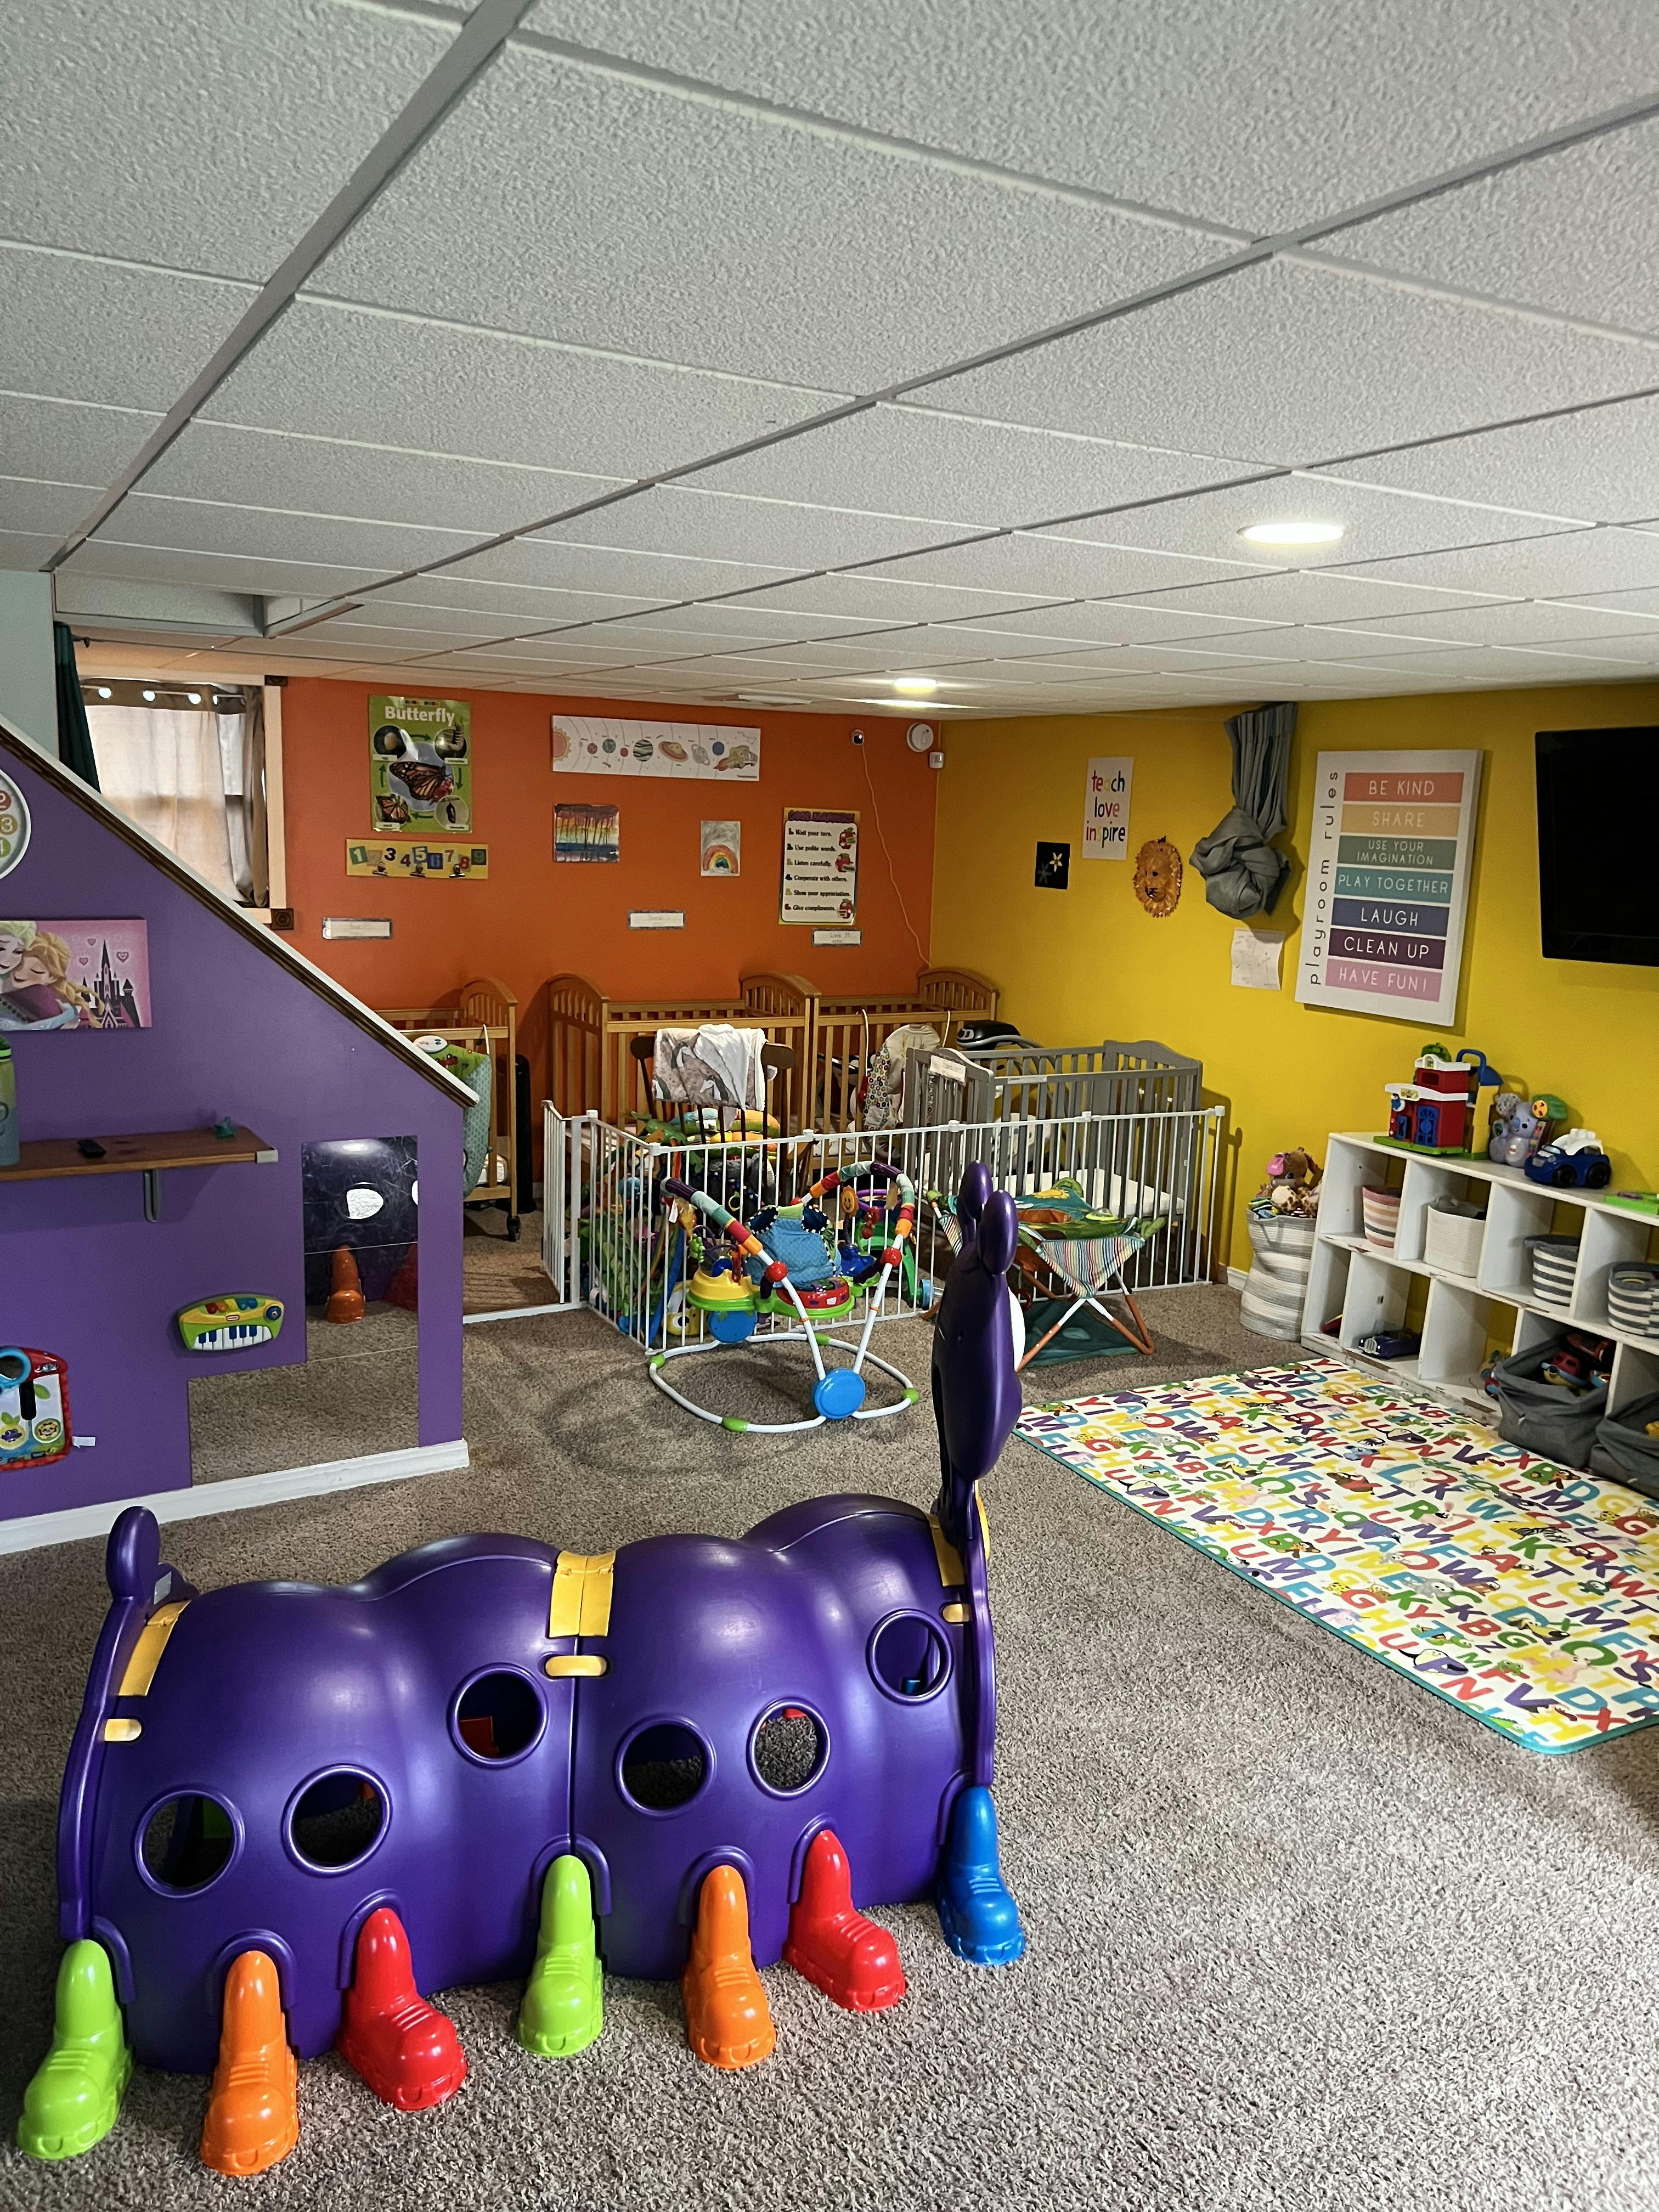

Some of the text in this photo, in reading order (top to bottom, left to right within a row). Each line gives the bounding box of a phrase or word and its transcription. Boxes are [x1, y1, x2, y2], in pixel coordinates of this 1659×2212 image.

[385, 706, 455, 727] Butterfly
[1092, 770, 1125, 792] teach
[1369, 780, 1435, 795] BE KIND
[1094, 797, 1120, 818] love
[788, 810, 811, 822] GOOD
[1373, 812, 1425, 828] SHARE
[2, 817, 13, 832] 3
[1086, 821, 1126, 848] inspire
[1368, 840, 1424, 852] USE YOUR
[353, 848, 363, 862] 1
[385, 848, 397, 861] 3
[400, 854, 411, 867] 4
[415, 847, 427, 861] 5
[431, 854, 441, 868] 6
[444, 849, 455, 863] 7
[460, 856, 470, 870] 8
[474, 851, 484, 864] 9
[1357, 851, 1434, 865] IMAGINATION
[1306, 772, 1339, 985] playroom rules
[1339, 874, 1448, 895] PLAY TOGETHER
[1361, 908, 1418, 927] LAUGH
[1344, 936, 1430, 959] CLEAN UP
[1339, 967, 1426, 992] HAVE FUN!
[1311, 1358, 1342, 1367] Y
[1268, 1374, 1313, 1387] M
[1299, 1372, 1328, 1383] D
[1210, 1382, 1250, 1395] W
[1075, 1397, 1111, 1406] Y
[1152, 1393, 1194, 1408] M
[1369, 1395, 1400, 1406] K
[1380, 1402, 1410, 1412] Y
[1116, 1405, 1143, 1415] A
[1235, 1408, 1276, 1421] K
[1023, 1415, 1070, 1432] M
[1055, 1414, 1088, 1426] D
[1201, 1417, 1243, 1430] A
[1248, 1421, 1284, 1433] T
[1361, 1419, 1391, 1429] U
[1418, 1428, 1444, 1439] M
[1084, 1439, 1121, 1452] G
[1125, 1441, 1159, 1454] K
[1239, 1443, 1270, 1454] U
[1406, 1444, 1446, 1457] N
[1096, 1452, 1133, 1468] H
[1132, 1450, 1165, 1460] Y
[1166, 1451, 1201, 1463] K
[1311, 1448, 1344, 1459] T
[1172, 1462, 1209, 1473] B
[1265, 1453, 1316, 1471] M
[1504, 1453, 1544, 1470] X
[1104, 1469, 1136, 1480] U
[1203, 1470, 1234, 1482] G
[1163, 1484, 1192, 1494] M
[1499, 1480, 1536, 1493] U
[1562, 1480, 1600, 1502] D
[1289, 1491, 1330, 1505] S
[1343, 1493, 1392, 1509] H
[1529, 1489, 1584, 1513] M
[1142, 1499, 1186, 1515] N
[1466, 1498, 1517, 1520] W
[1234, 1508, 1274, 1523] D
[1369, 1510, 1404, 1523] U
[1245, 1520, 1288, 1536] X
[1440, 1519, 1475, 1532] I
[1313, 1528, 1358, 1544] Y
[1402, 1523, 1455, 1545] M
[1231, 1543, 1269, 1558] U
[1328, 1546, 1365, 1556] I
[1364, 1541, 1397, 1553] A
[1508, 1536, 1557, 1560] K
[1258, 1558, 1317, 1581] M
[1296, 1554, 1336, 1571] D
[1470, 1554, 1521, 1573] A
[1531, 1560, 1575, 1578] T
[1389, 1590, 1433, 1611] K
[1527, 1593, 1568, 1609] U
[1404, 1604, 1445, 1619] Y
[1444, 1604, 1488, 1622] K
[1361, 1608, 1409, 1633] H
[1565, 1607, 1630, 1632] M
[1457, 1619, 1502, 1637] B
[1379, 1633, 1419, 1650] U
[1497, 1631, 1538, 1649] G
[1456, 1652, 1493, 1668] M
[1438, 1676, 1494, 1701] N
[1555, 1686, 1608, 1711] D
[1576, 1707, 1630, 1733] X
